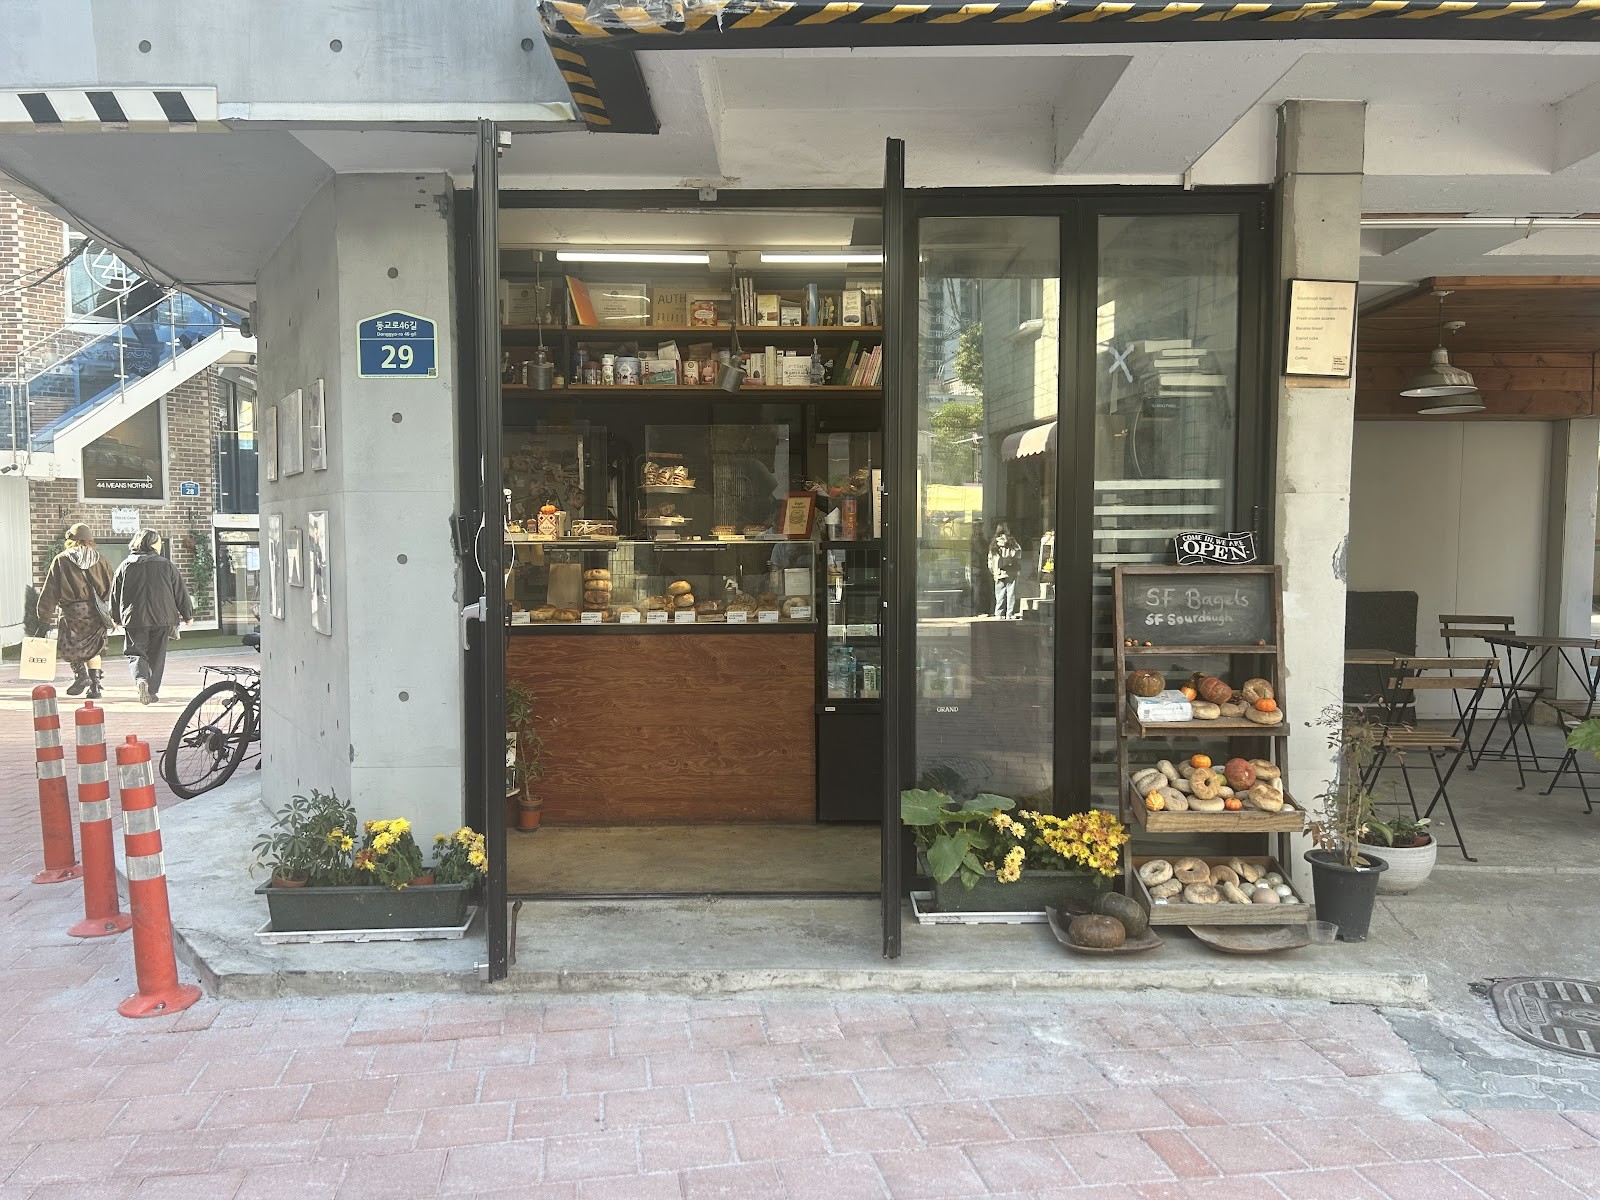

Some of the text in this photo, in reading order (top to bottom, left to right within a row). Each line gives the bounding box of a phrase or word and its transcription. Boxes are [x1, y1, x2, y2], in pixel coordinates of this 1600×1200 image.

[376, 321, 417, 331] 동교로46길
[381, 345, 413, 368] 29
[1215, 538, 1226, 546] WE
[1145, 587, 1249, 612] SF Bagels
[1145, 611, 1234, 626] SF Sourdough
